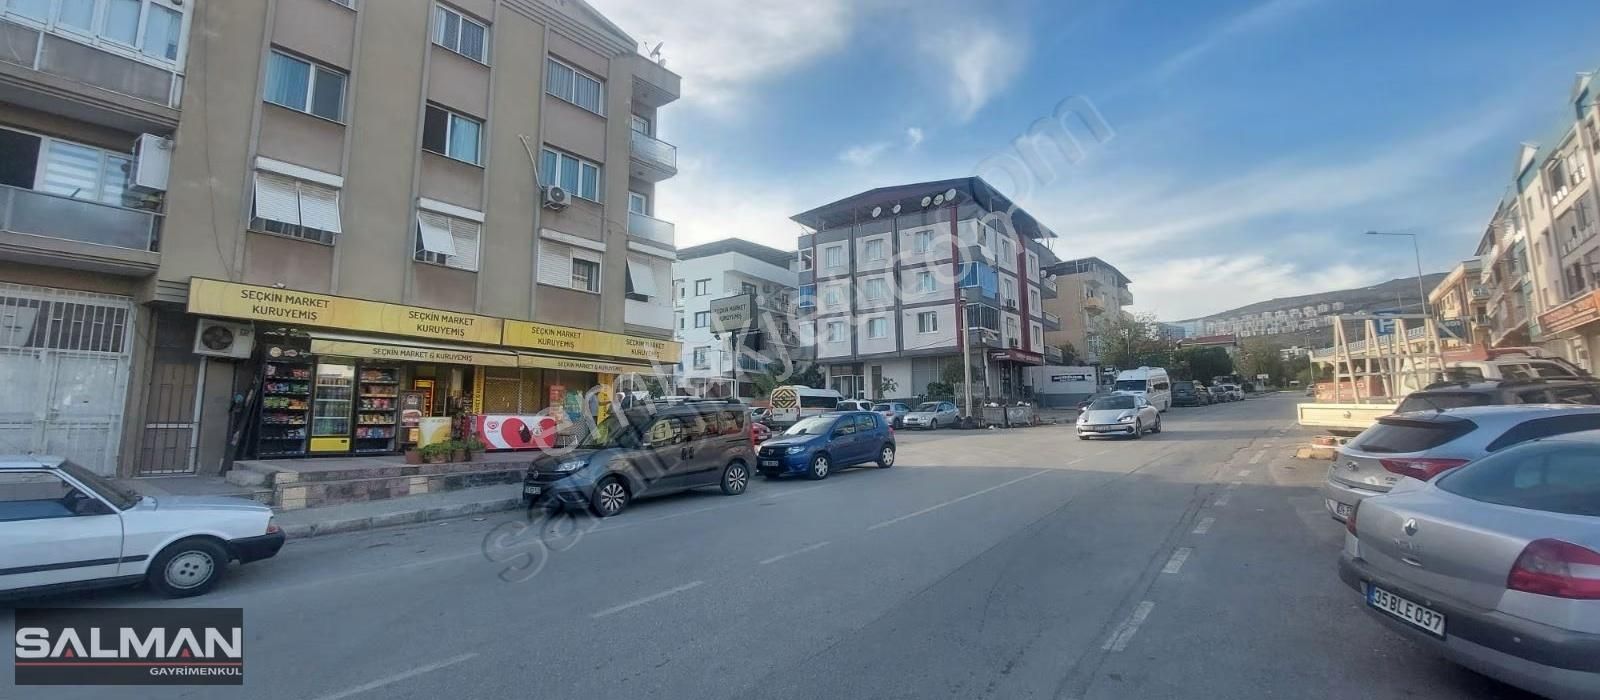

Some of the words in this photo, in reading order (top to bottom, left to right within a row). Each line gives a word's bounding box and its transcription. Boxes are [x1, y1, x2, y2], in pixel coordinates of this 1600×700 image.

[241, 289, 282, 303] SEÇKİN
[285, 295, 330, 309] MARKET
[409, 310, 439, 323] SEÇKİN
[441, 314, 475, 326] MARKET
[556, 329, 581, 340] MARKET
[373, 347, 399, 356] SEÇKİN
[400, 350, 428, 359] MARKET
[1374, 589, 1389, 608] 35
[1390, 595, 1414, 619] BLE
[1414, 606, 1442, 630] 037
